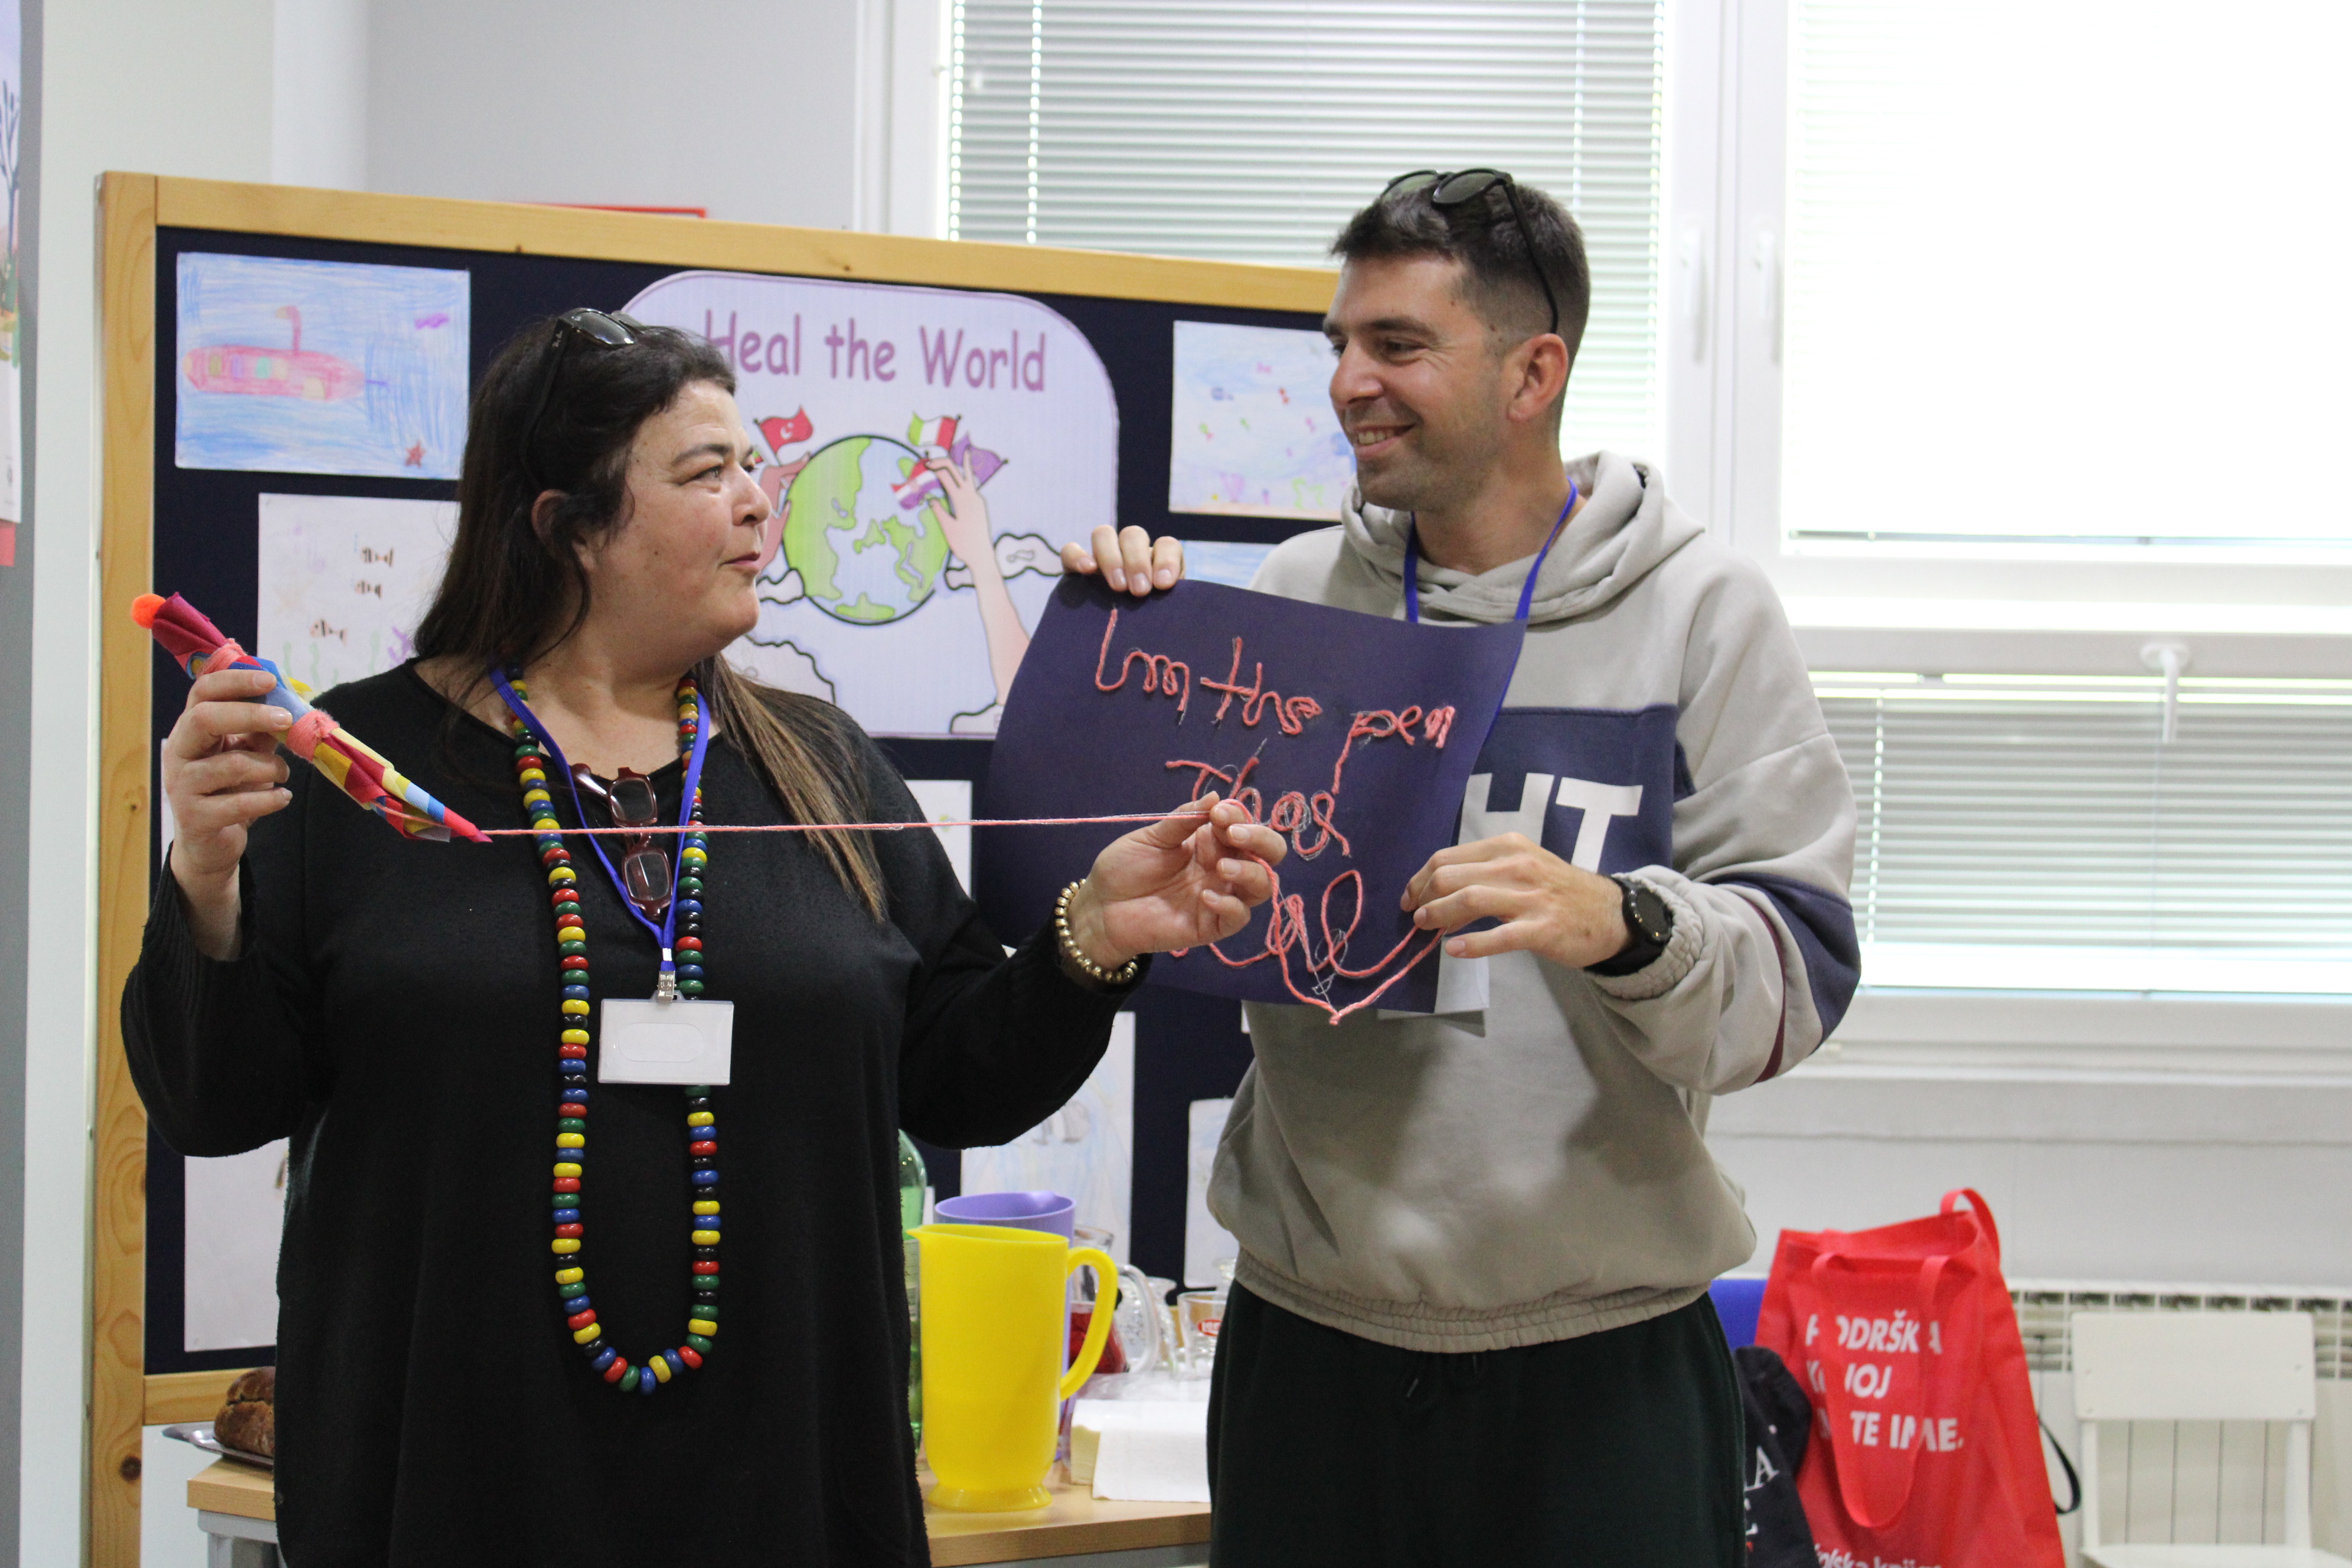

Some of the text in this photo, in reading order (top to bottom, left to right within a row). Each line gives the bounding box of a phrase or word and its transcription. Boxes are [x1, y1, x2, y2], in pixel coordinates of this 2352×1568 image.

[705, 309, 1044, 391] Heal the World
